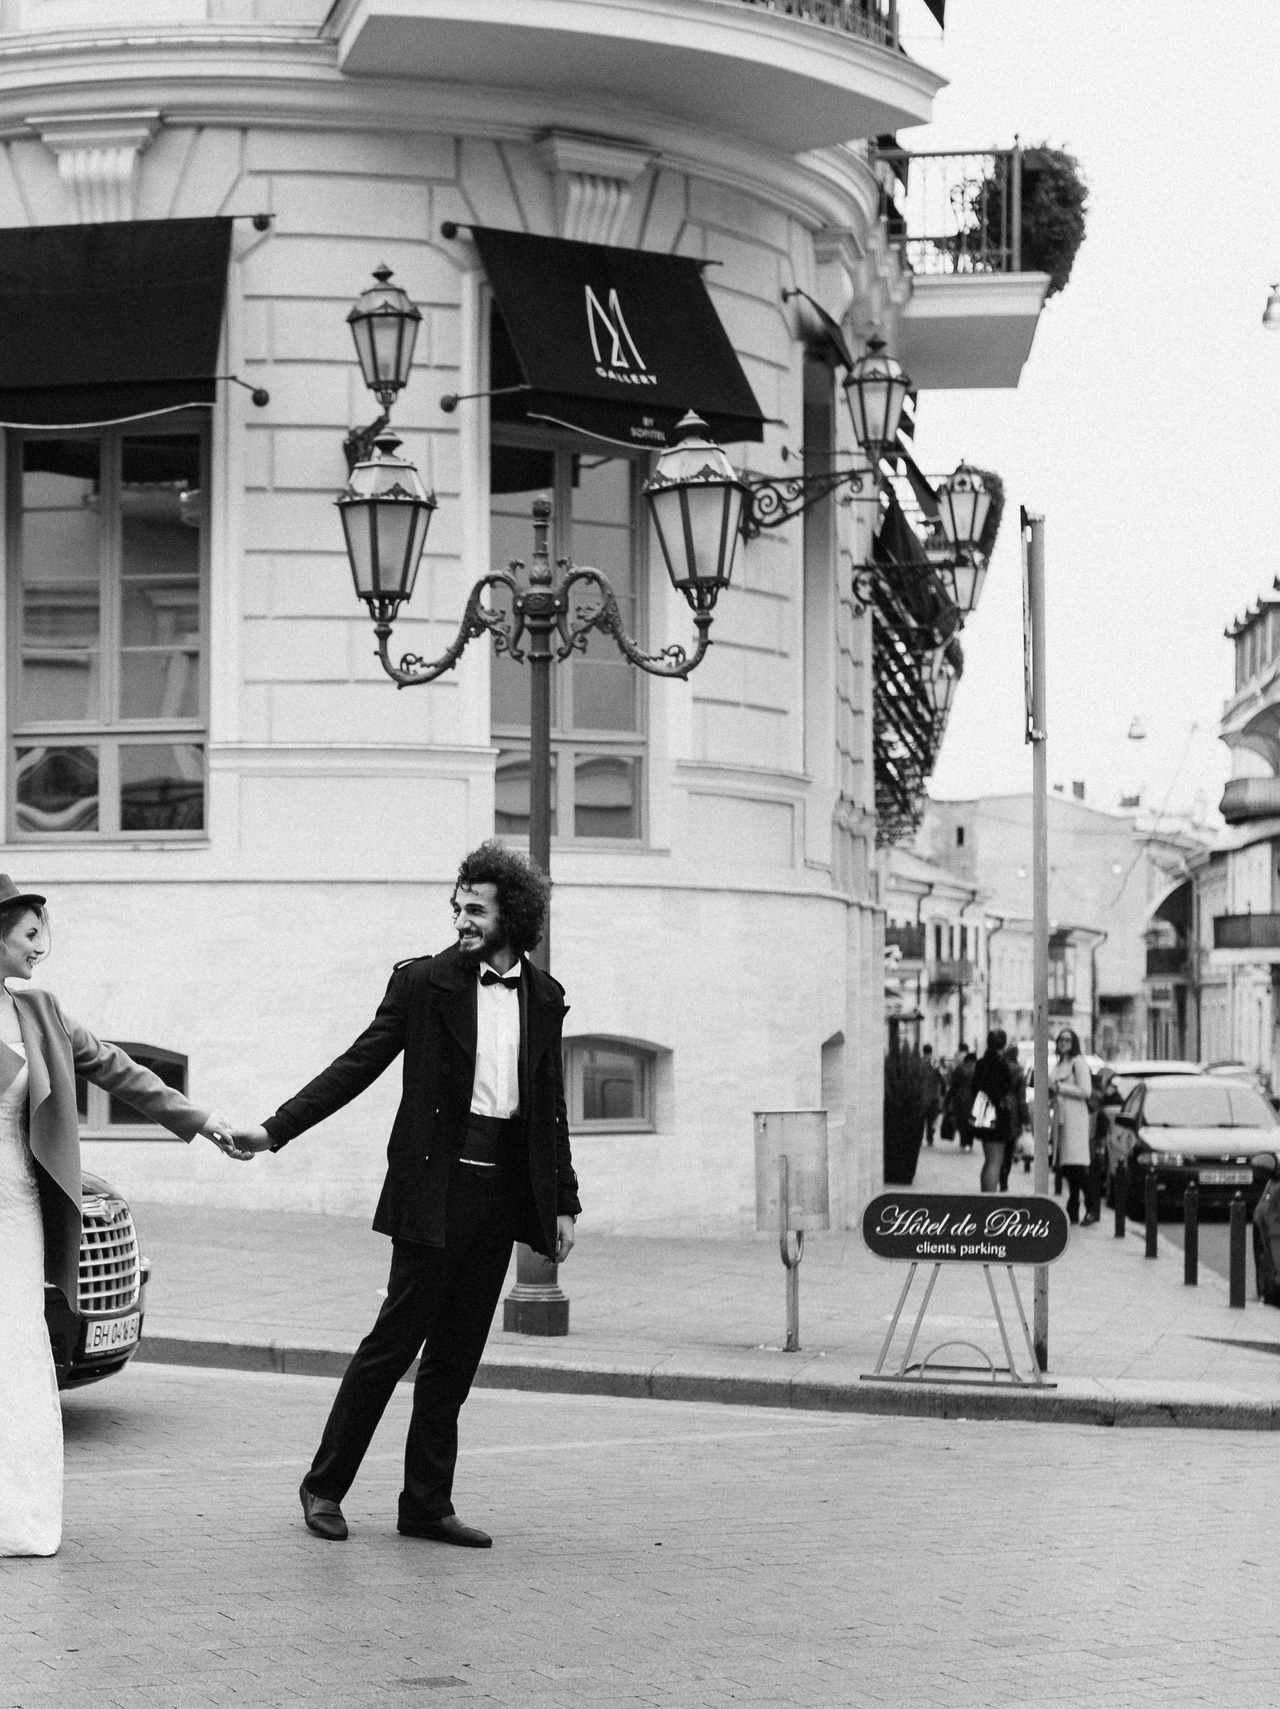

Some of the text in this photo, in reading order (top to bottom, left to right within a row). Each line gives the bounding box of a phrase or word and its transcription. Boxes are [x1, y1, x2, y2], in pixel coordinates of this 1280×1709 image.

[595, 366, 657, 385] GALLERY
[876, 1204, 1050, 1237] Hôtel de Paris
[916, 1241, 1007, 1258] clients parking
[94, 1324, 110, 1347] BH
